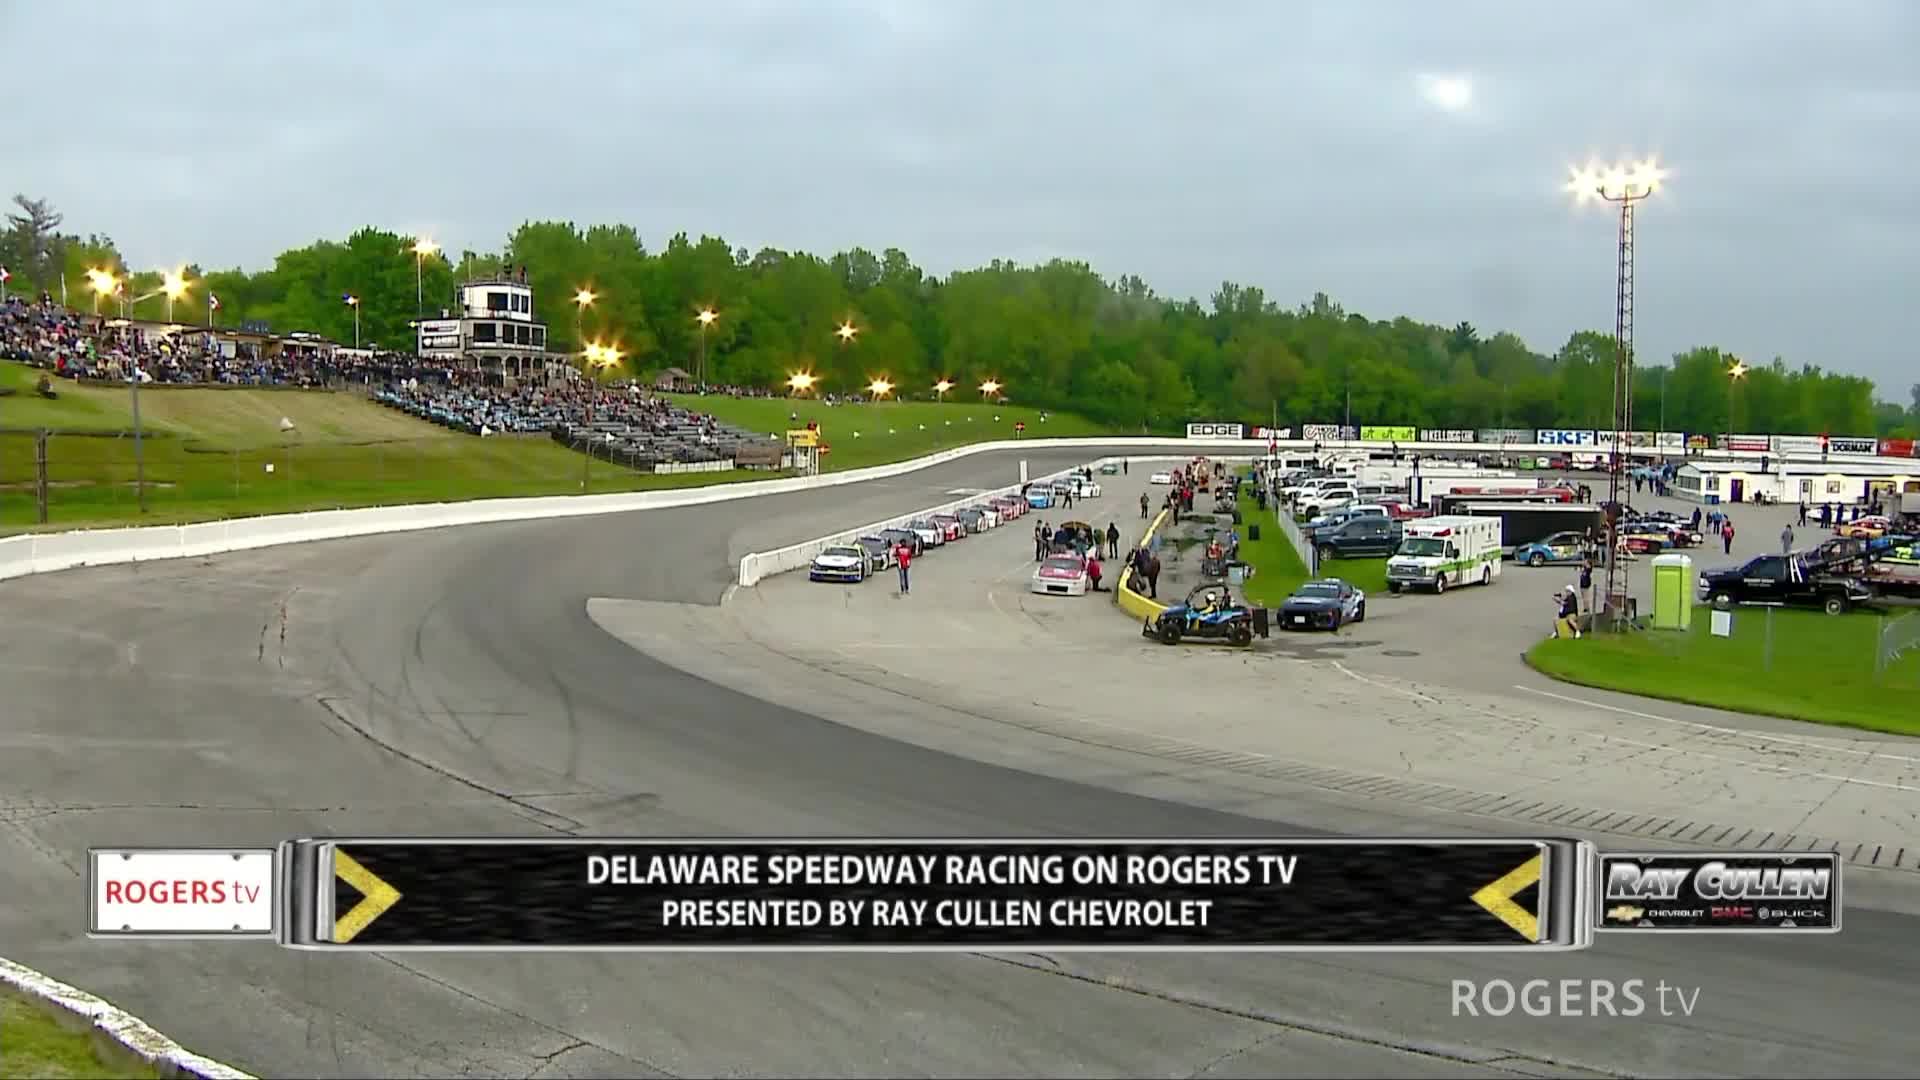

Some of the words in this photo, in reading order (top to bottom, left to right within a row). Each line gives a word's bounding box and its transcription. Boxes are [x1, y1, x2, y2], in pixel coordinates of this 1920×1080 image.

[1191, 424, 1240, 436] EDGE
[1539, 431, 1593, 445] SKF
[1832, 443, 1873, 453] DORMAN
